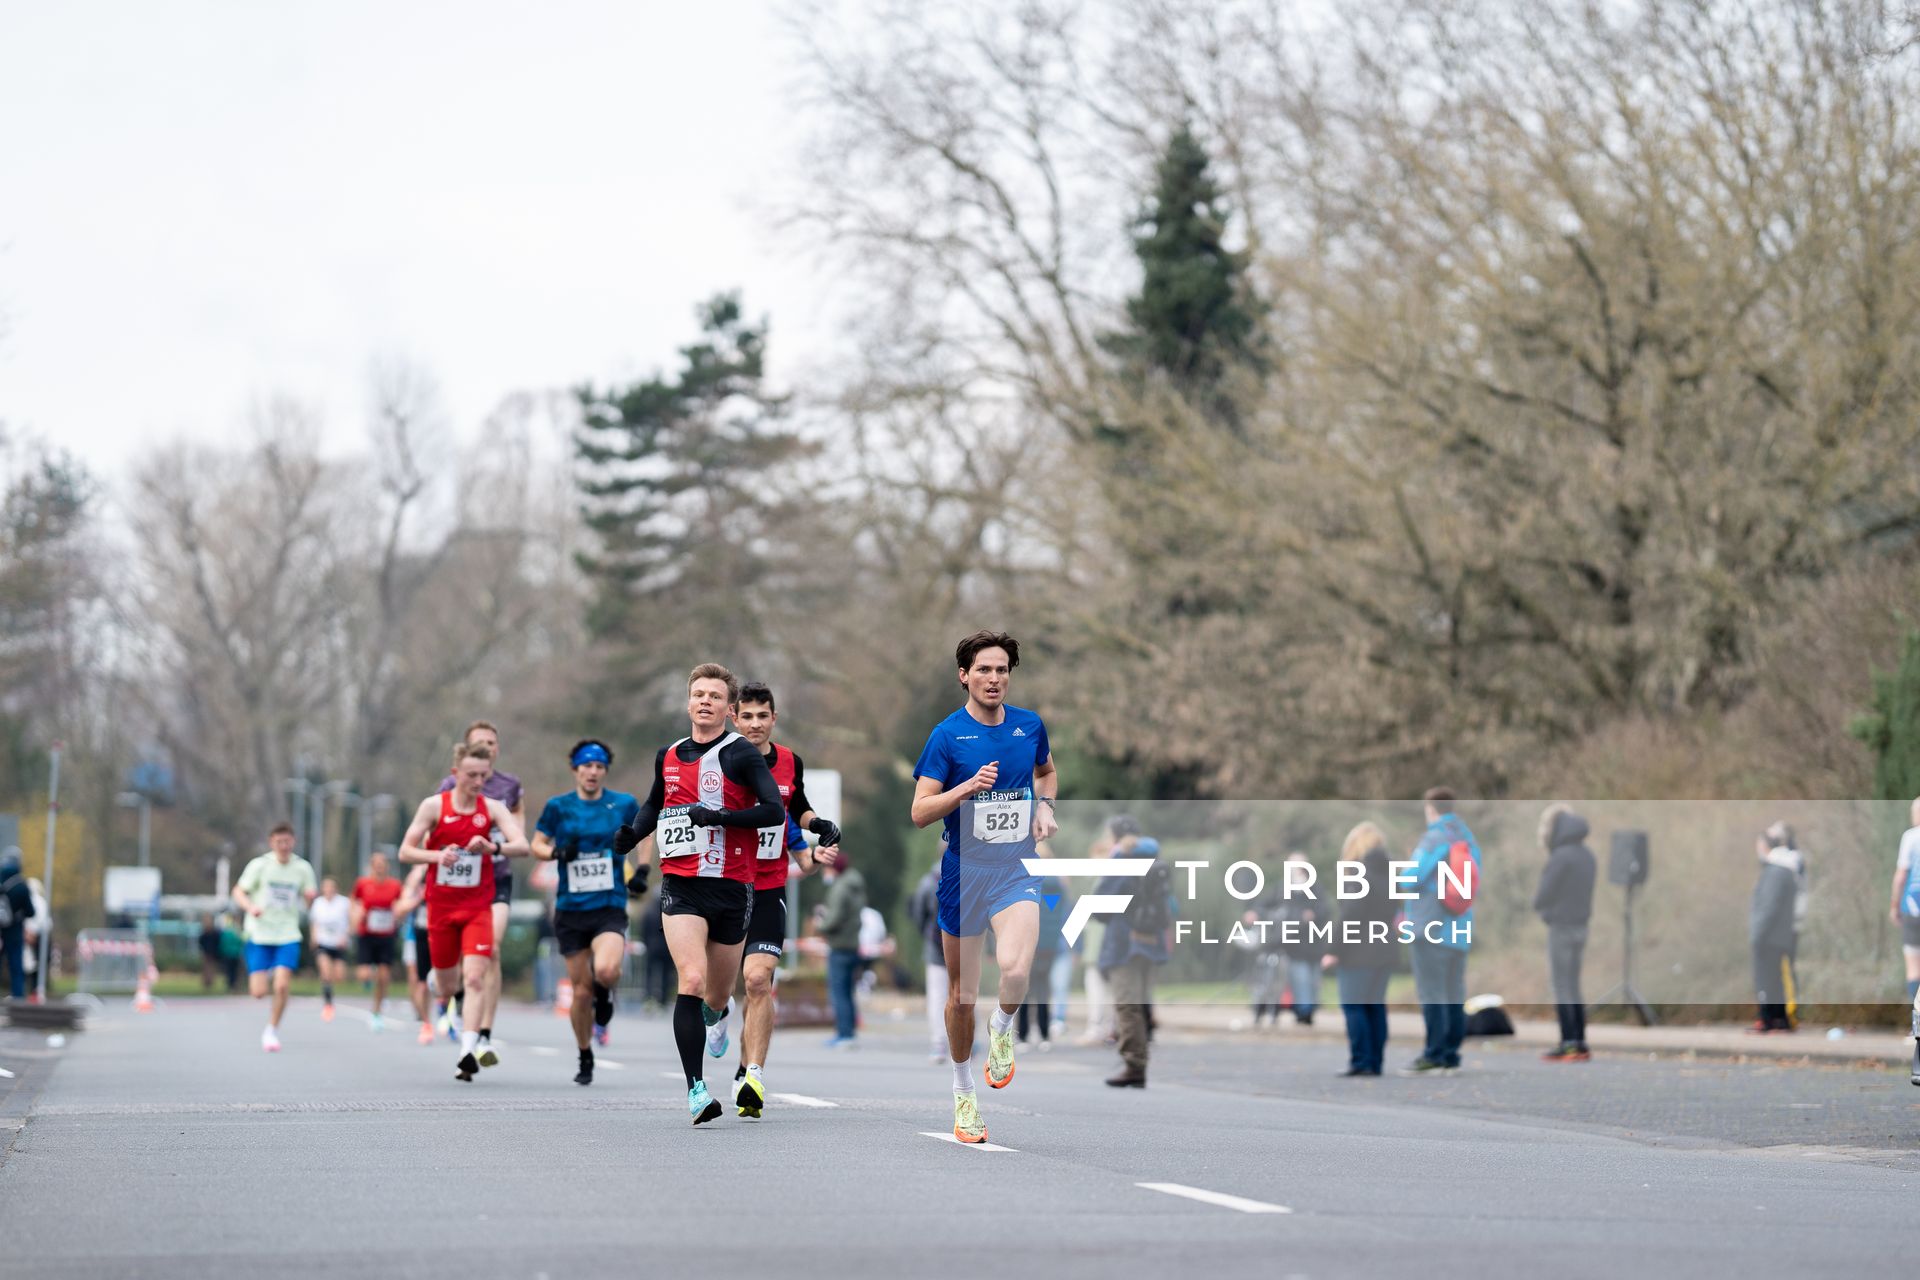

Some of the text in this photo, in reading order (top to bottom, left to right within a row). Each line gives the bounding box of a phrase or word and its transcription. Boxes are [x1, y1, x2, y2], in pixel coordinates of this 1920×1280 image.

[991, 791, 1019, 802] Bayer
[666, 807, 690, 817] Bayer
[986, 812, 1020, 831] 523
[664, 826, 696, 846] 225
[573, 863, 607, 878] 1532
